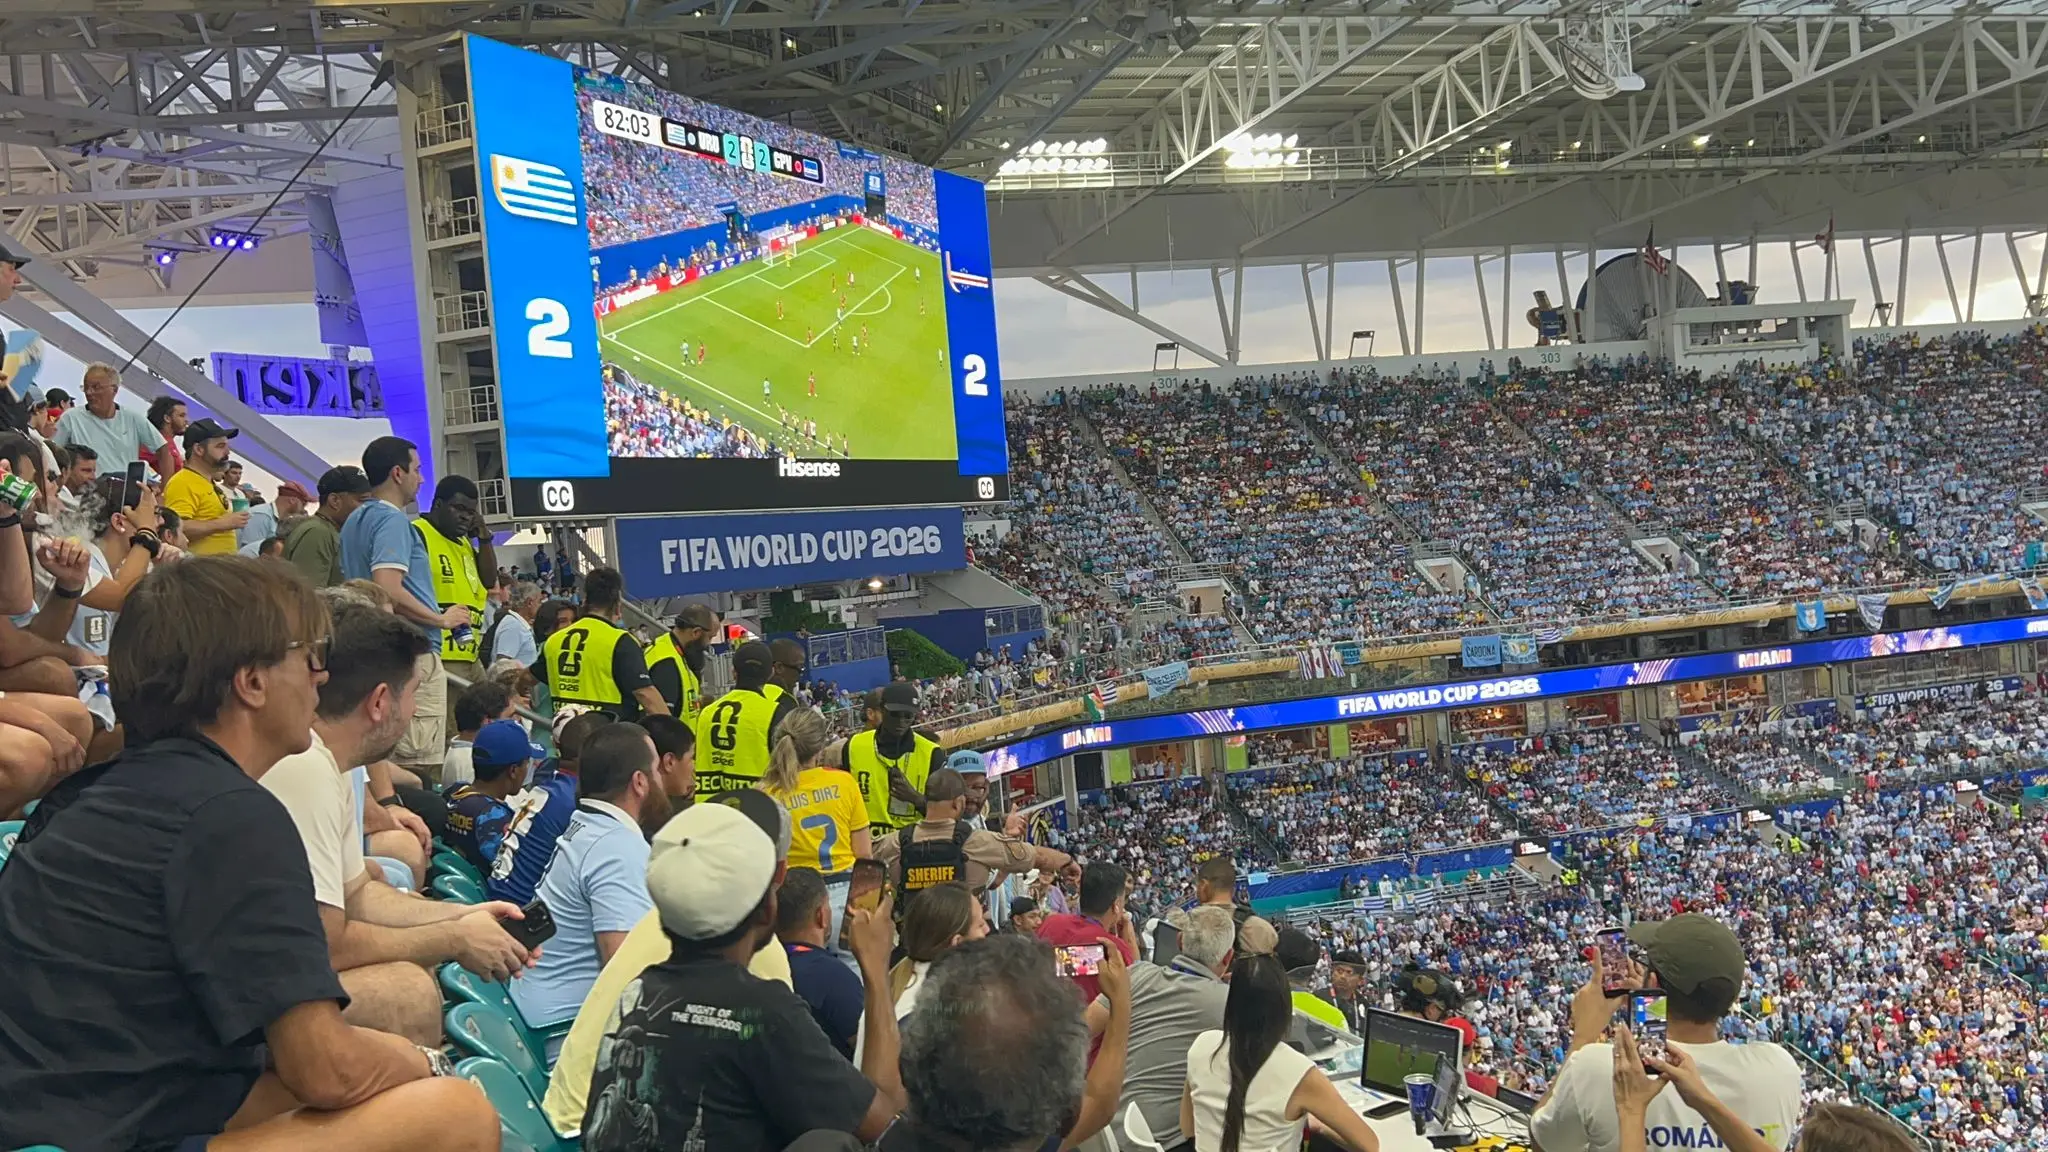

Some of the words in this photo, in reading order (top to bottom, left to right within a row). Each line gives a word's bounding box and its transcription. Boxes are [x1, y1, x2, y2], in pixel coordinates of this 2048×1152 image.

[603, 106, 650, 137] 82:03
[728, 141, 736, 159] 2
[758, 149, 767, 166] 2
[525, 297, 573, 359] 2
[1540, 352, 1560, 364] 303
[963, 353, 988, 396] 2
[1158, 377, 1178, 389] 301
[778, 458, 841, 477] Hisense
[547, 485, 570, 507] CC
[661, 537, 726, 574] FIFA
[726, 532, 818, 569] WORLD
[821, 530, 868, 562] CUP
[871, 525, 942, 557] 2026
[1739, 648, 1792, 668] MIAMI
[1338, 698, 1378, 716] FIFA
[1378, 688, 1442, 711] WORLD
[1443, 684, 1479, 703] CUP
[1479, 678, 1540, 698] 2026
[1063, 726, 1112, 749] MIAMI
[783, 793, 809, 810] LUIS
[801, 814, 837, 870] 7
[907, 866, 955, 881] SHERIFF
[685, 1004, 717, 1016] NIGHT
[717, 1008, 732, 1018] OF
[671, 1012, 691, 1022] THE
[691, 1014, 742, 1032] DEMIGODS
